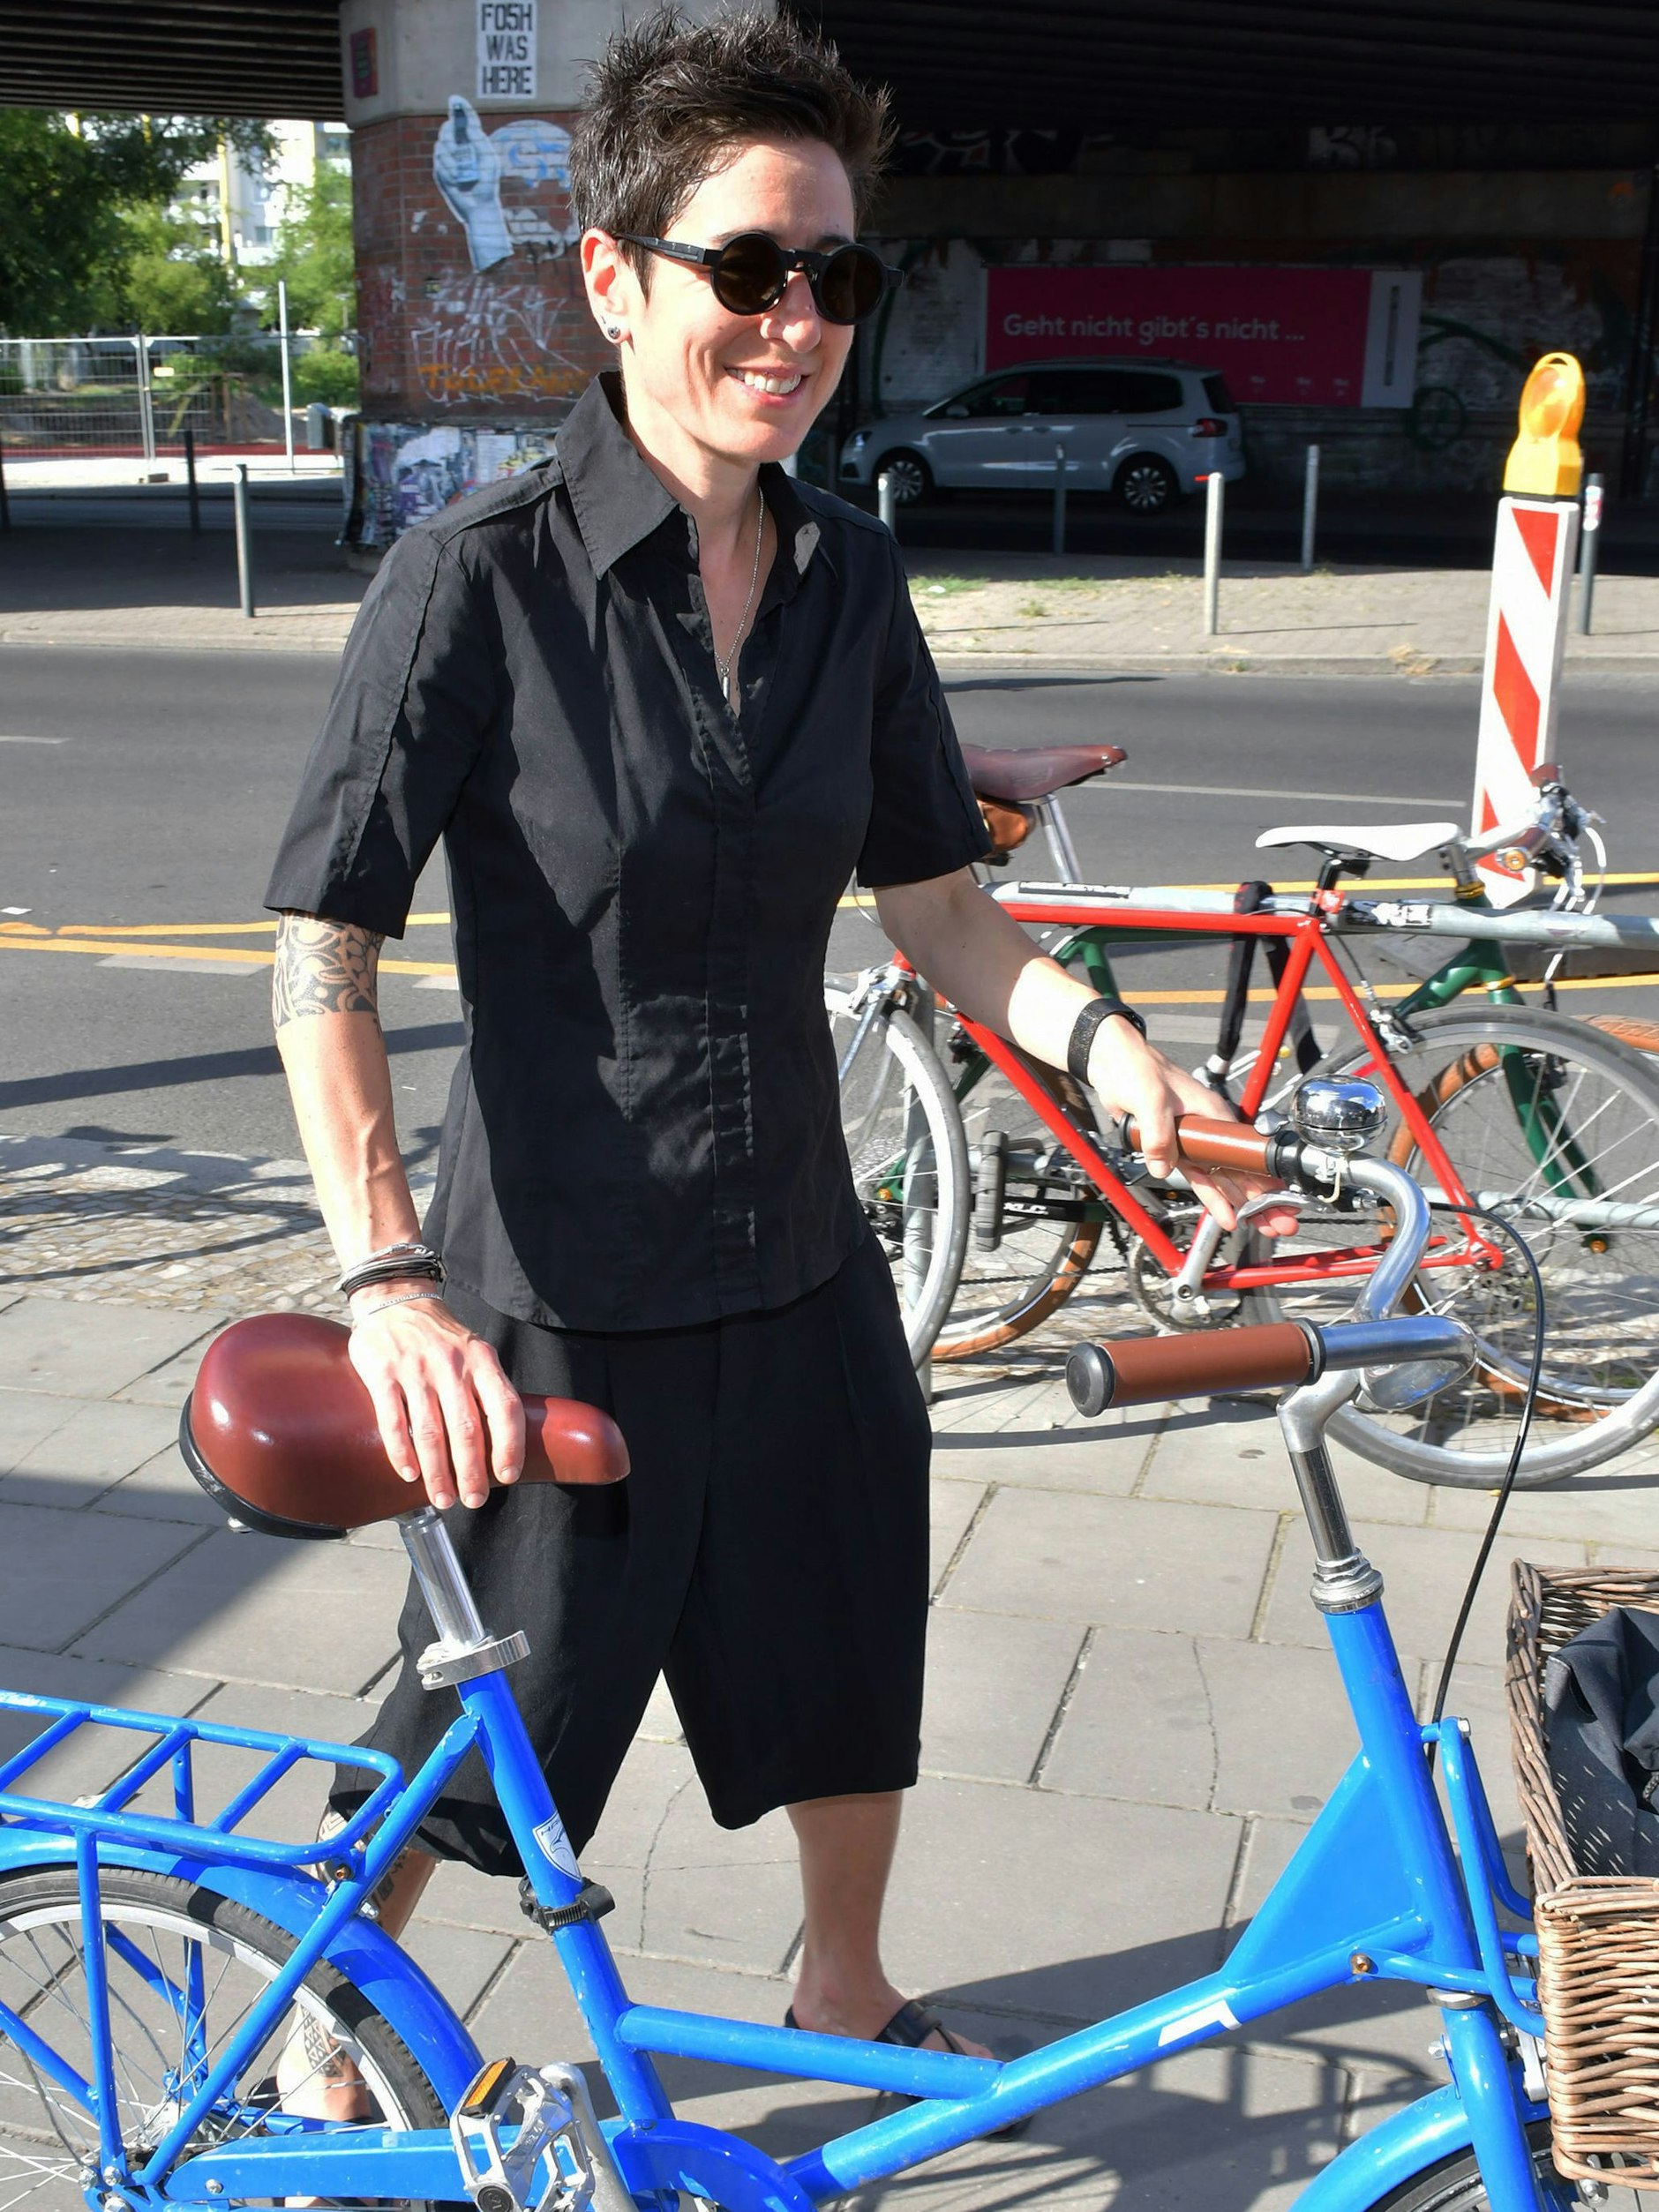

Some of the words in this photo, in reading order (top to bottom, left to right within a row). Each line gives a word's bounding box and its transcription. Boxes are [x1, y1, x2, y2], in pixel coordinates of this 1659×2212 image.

[482, 4, 532, 31] FOSH
[486, 35, 528, 61] WAS
[482, 66, 532, 94] HERE
[1002, 313, 1065, 336] Geht
[1071, 315, 1132, 337] nicht
[1214, 318, 1279, 340] nicht
